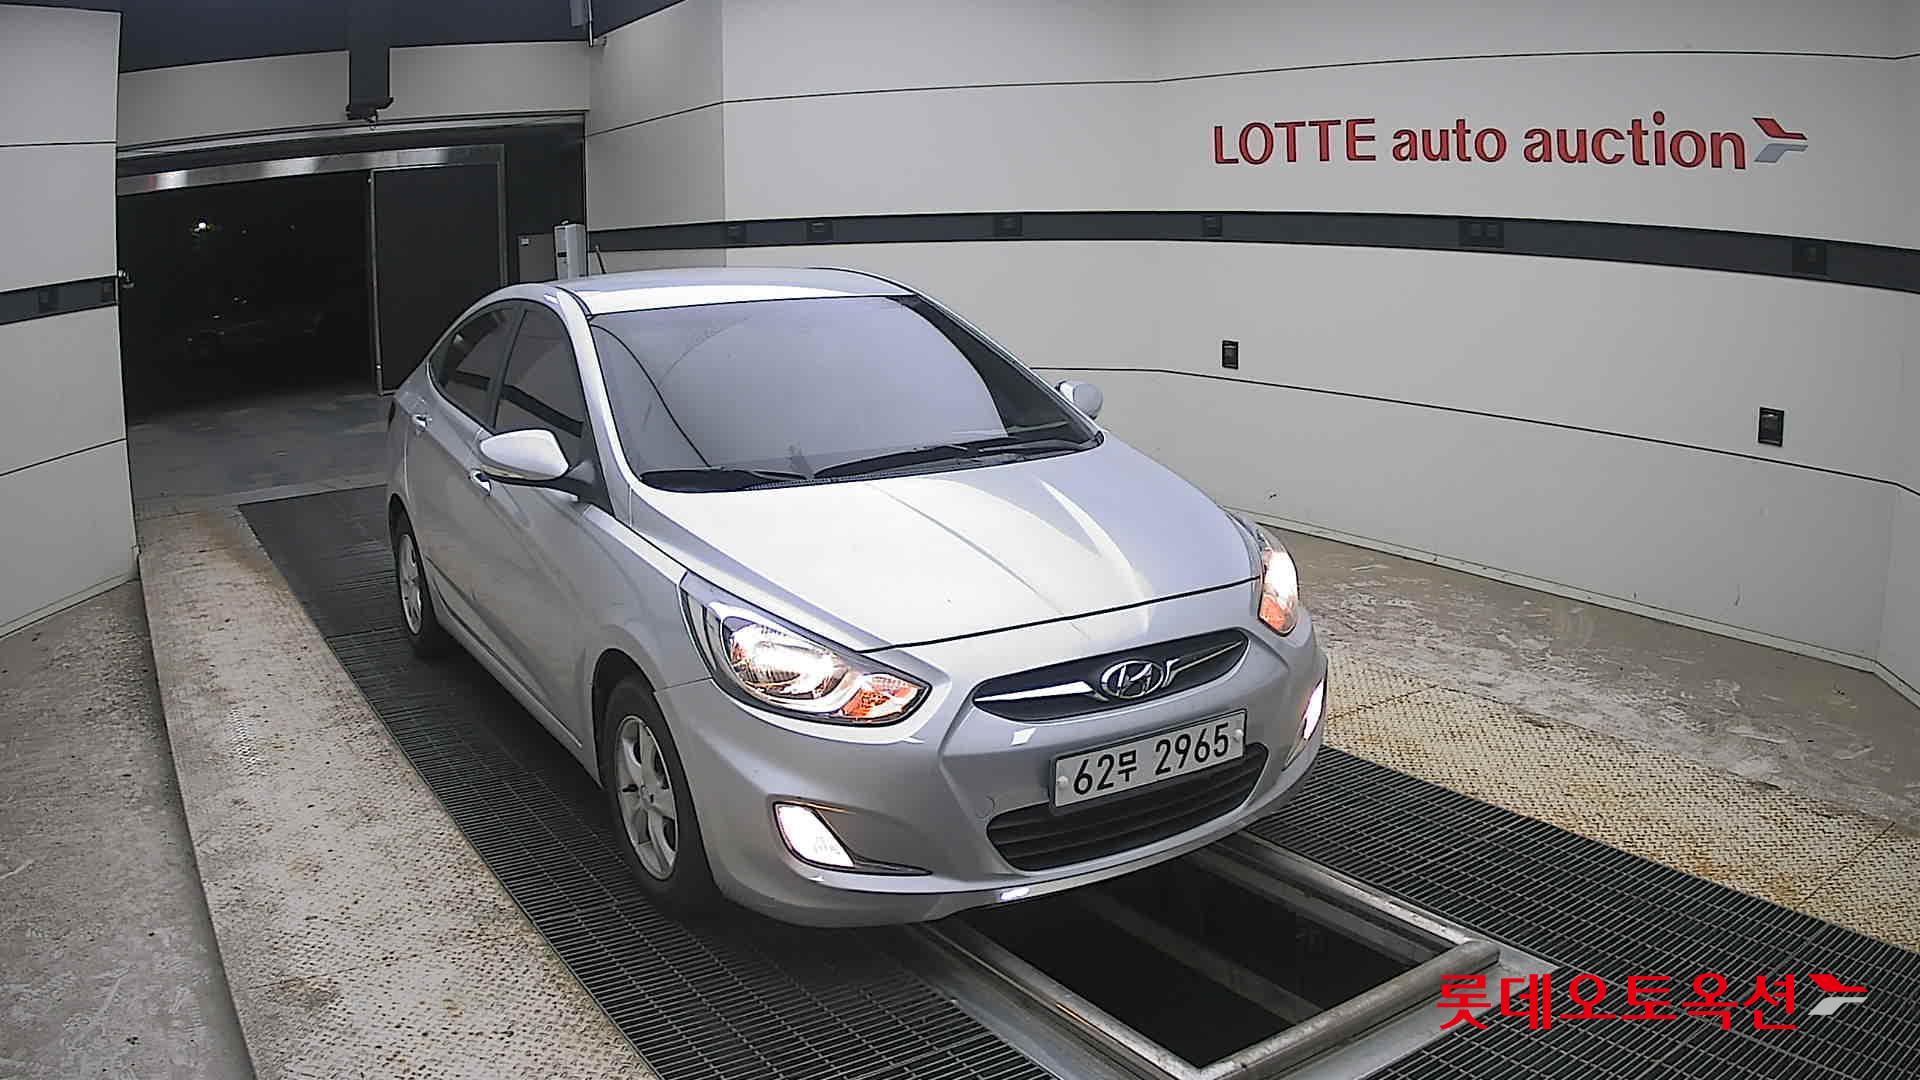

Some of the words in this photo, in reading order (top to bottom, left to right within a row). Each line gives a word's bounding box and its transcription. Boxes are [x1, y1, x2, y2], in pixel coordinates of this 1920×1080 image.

[1213, 118, 1376, 165] LOTTE
[1391, 119, 1508, 163] auto
[1522, 111, 1746, 170] auction
[1073, 749, 1137, 795] 62무
[1155, 722, 1229, 775] 2965
